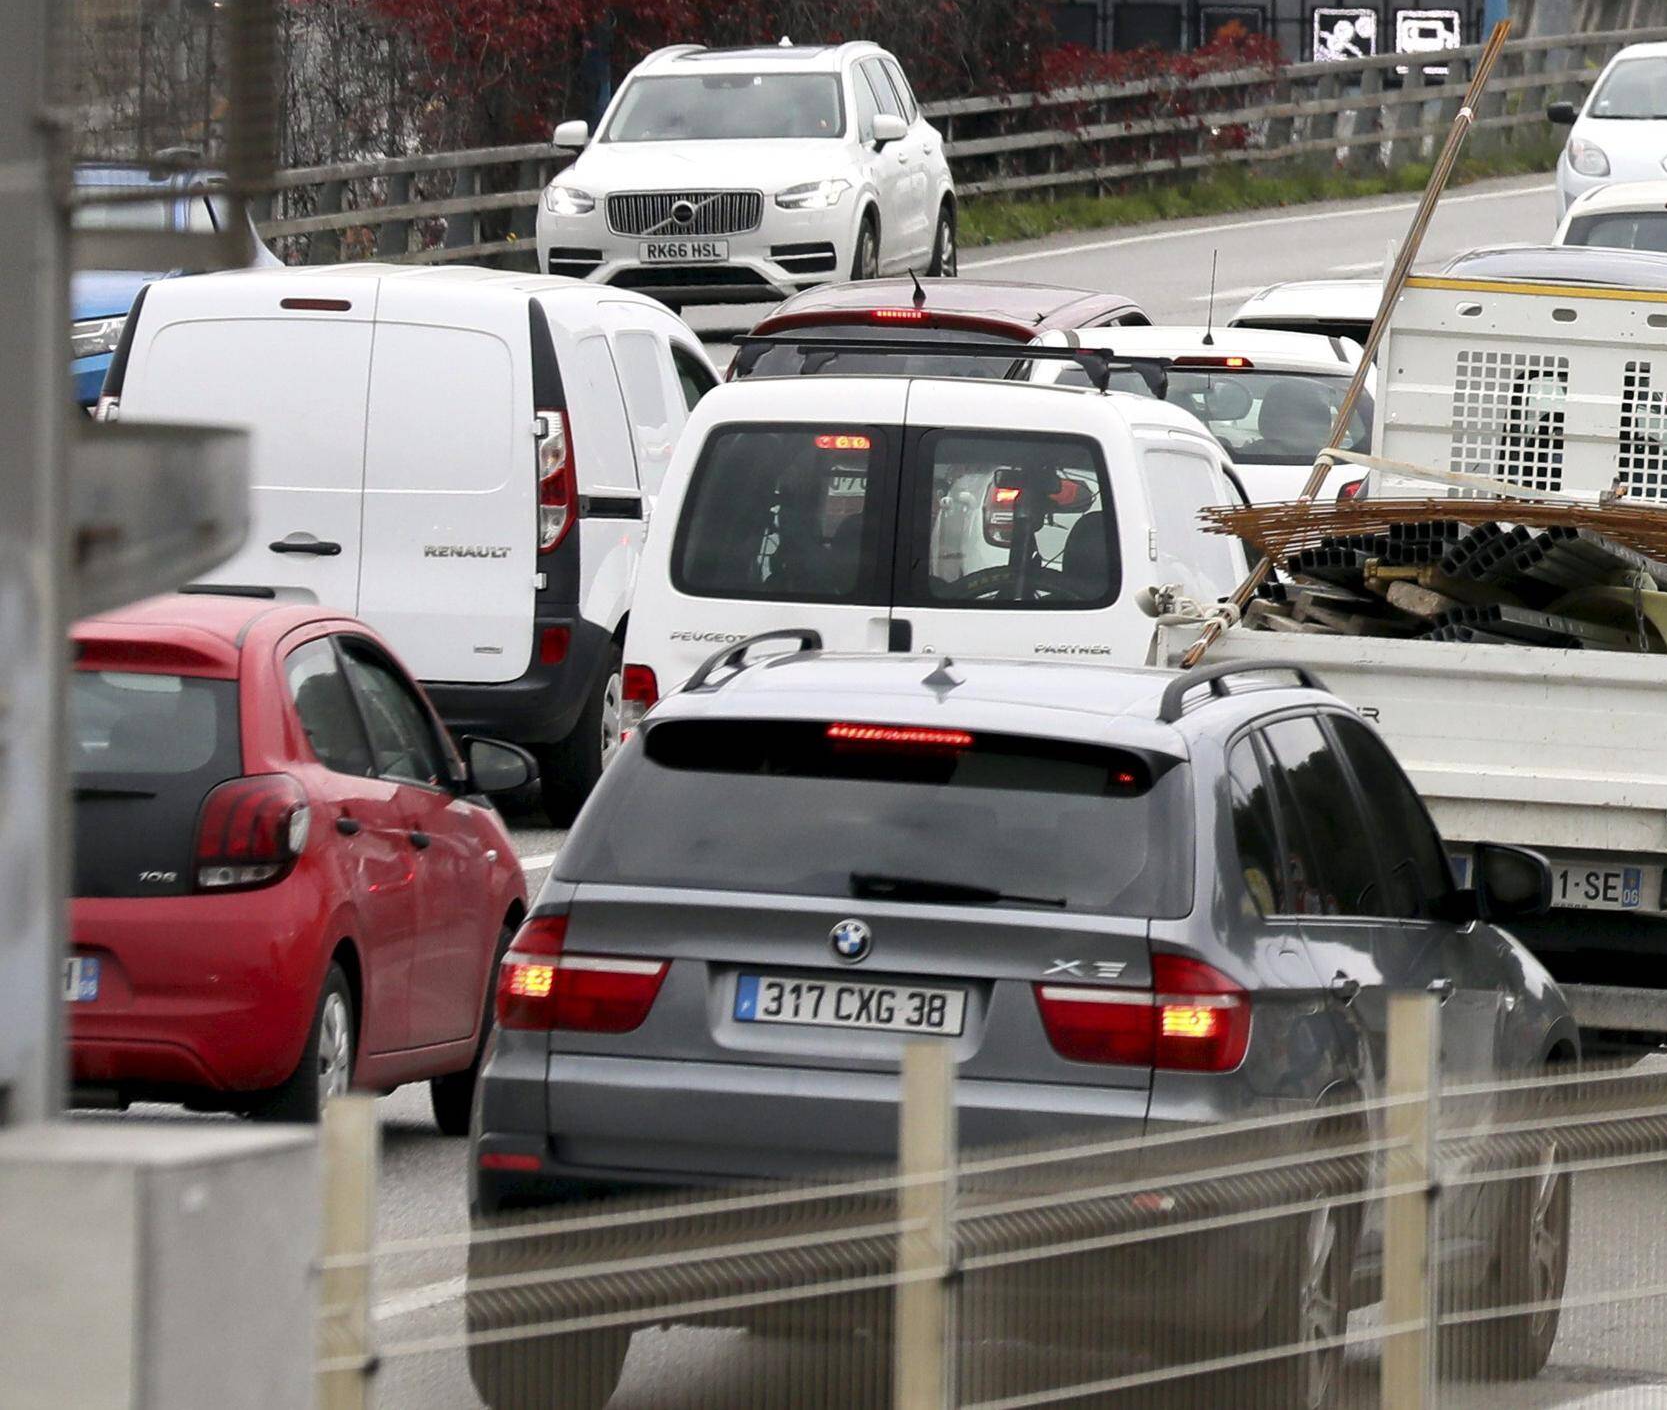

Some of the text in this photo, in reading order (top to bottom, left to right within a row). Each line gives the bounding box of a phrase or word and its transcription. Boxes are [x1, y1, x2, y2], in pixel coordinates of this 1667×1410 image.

[647, 243, 722, 259] RK66 HSL
[424, 545, 512, 558] RENAULT
[669, 631, 748, 644] PEUGEOT
[763, 981, 947, 1029] 317 CXG 38
